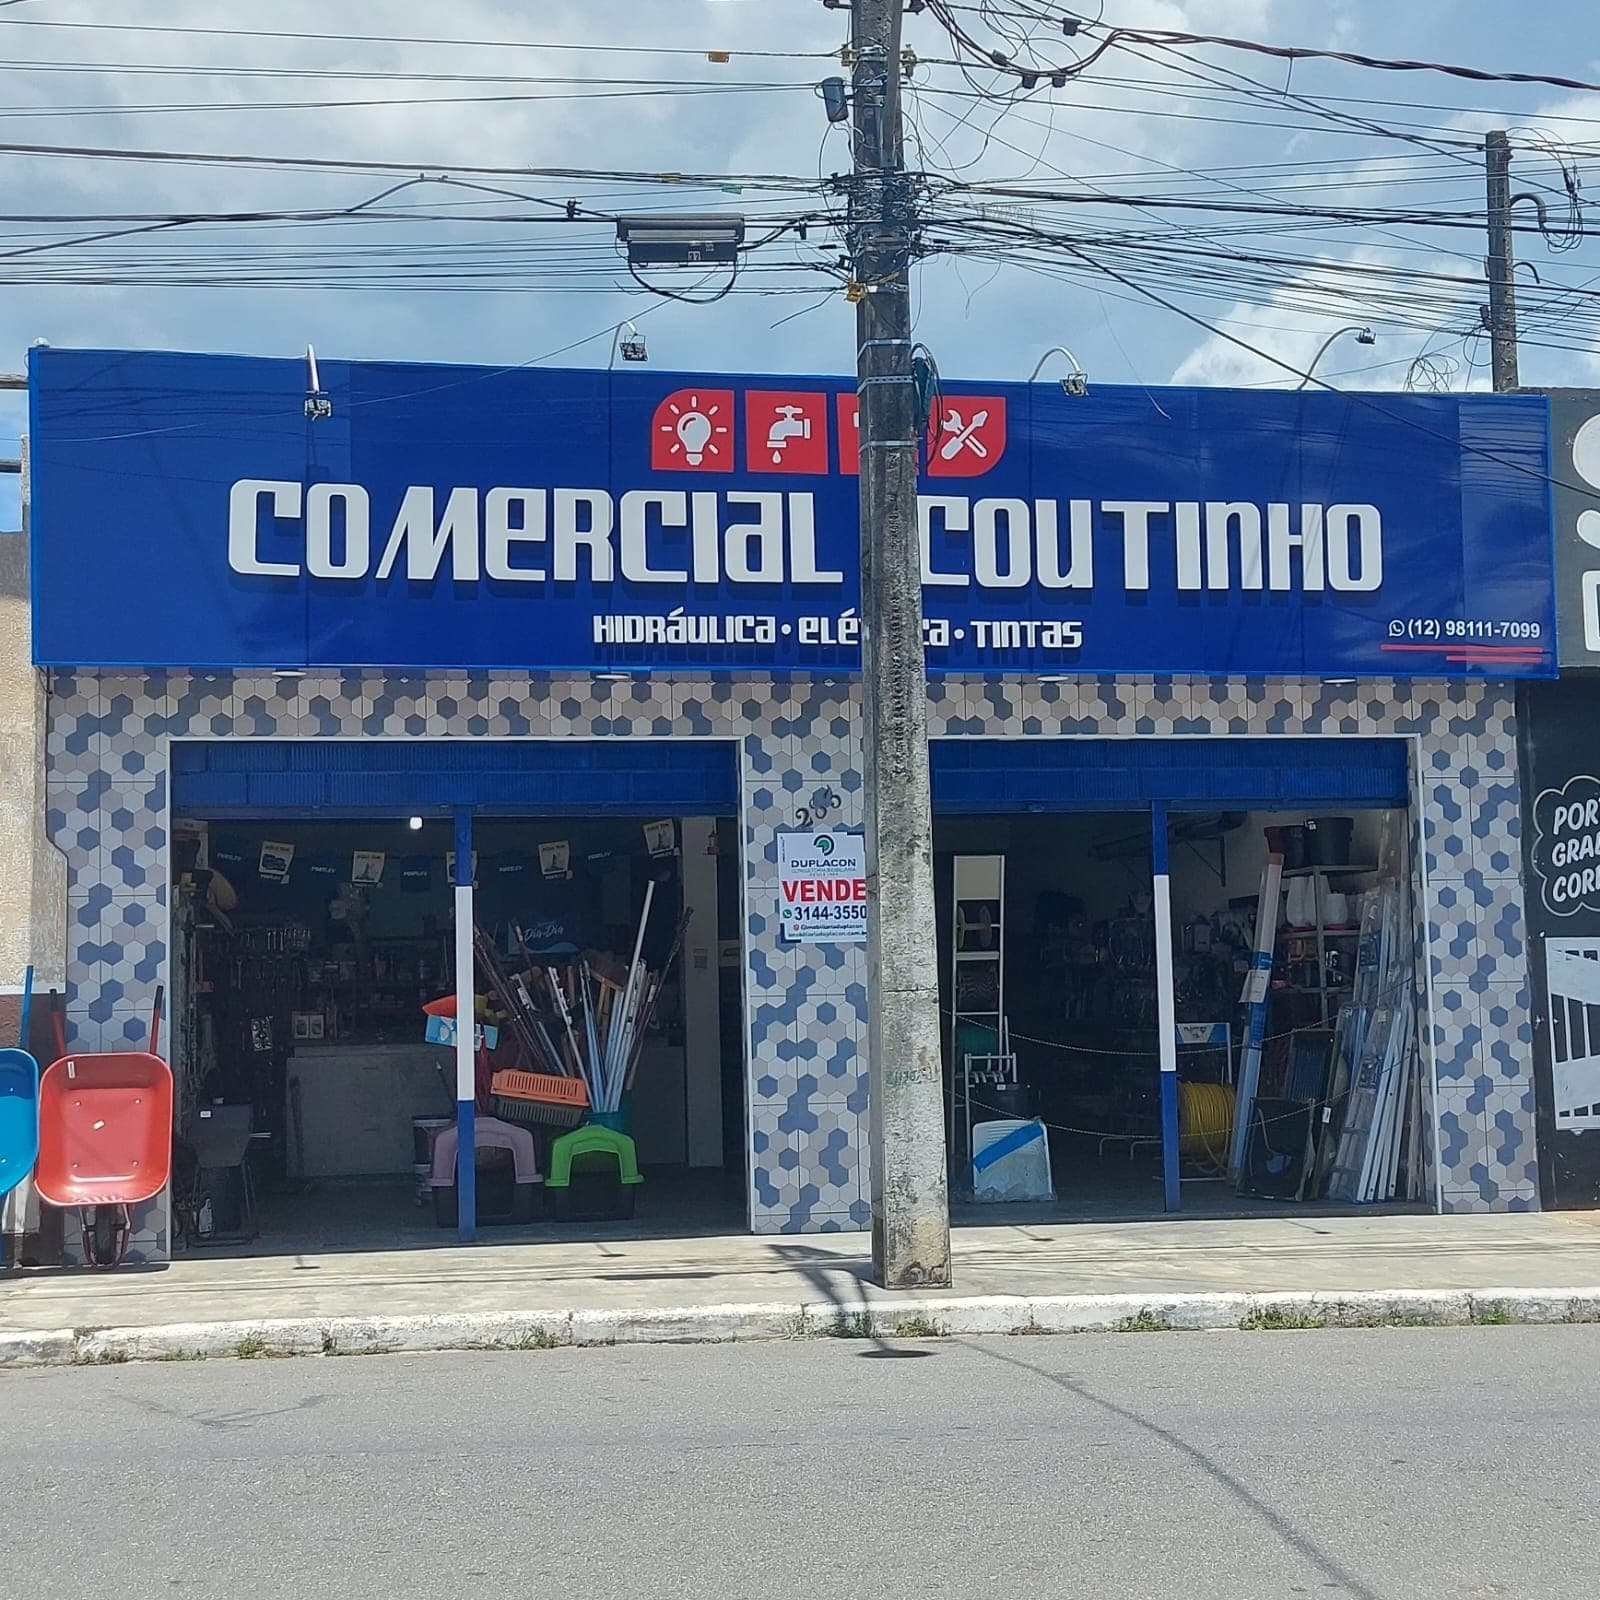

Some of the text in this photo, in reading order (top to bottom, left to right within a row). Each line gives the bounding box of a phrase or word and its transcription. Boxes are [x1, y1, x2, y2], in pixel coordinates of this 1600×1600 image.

[970, 620, 1083, 649] TINTAS
[1408, 618, 1541, 640] (12) 98111-7099
[1553, 798, 1600, 835] POR
[791, 858, 856, 868] DUPLACON
[782, 878, 867, 902] VENDE
[794, 904, 867, 920] 3144-3550
